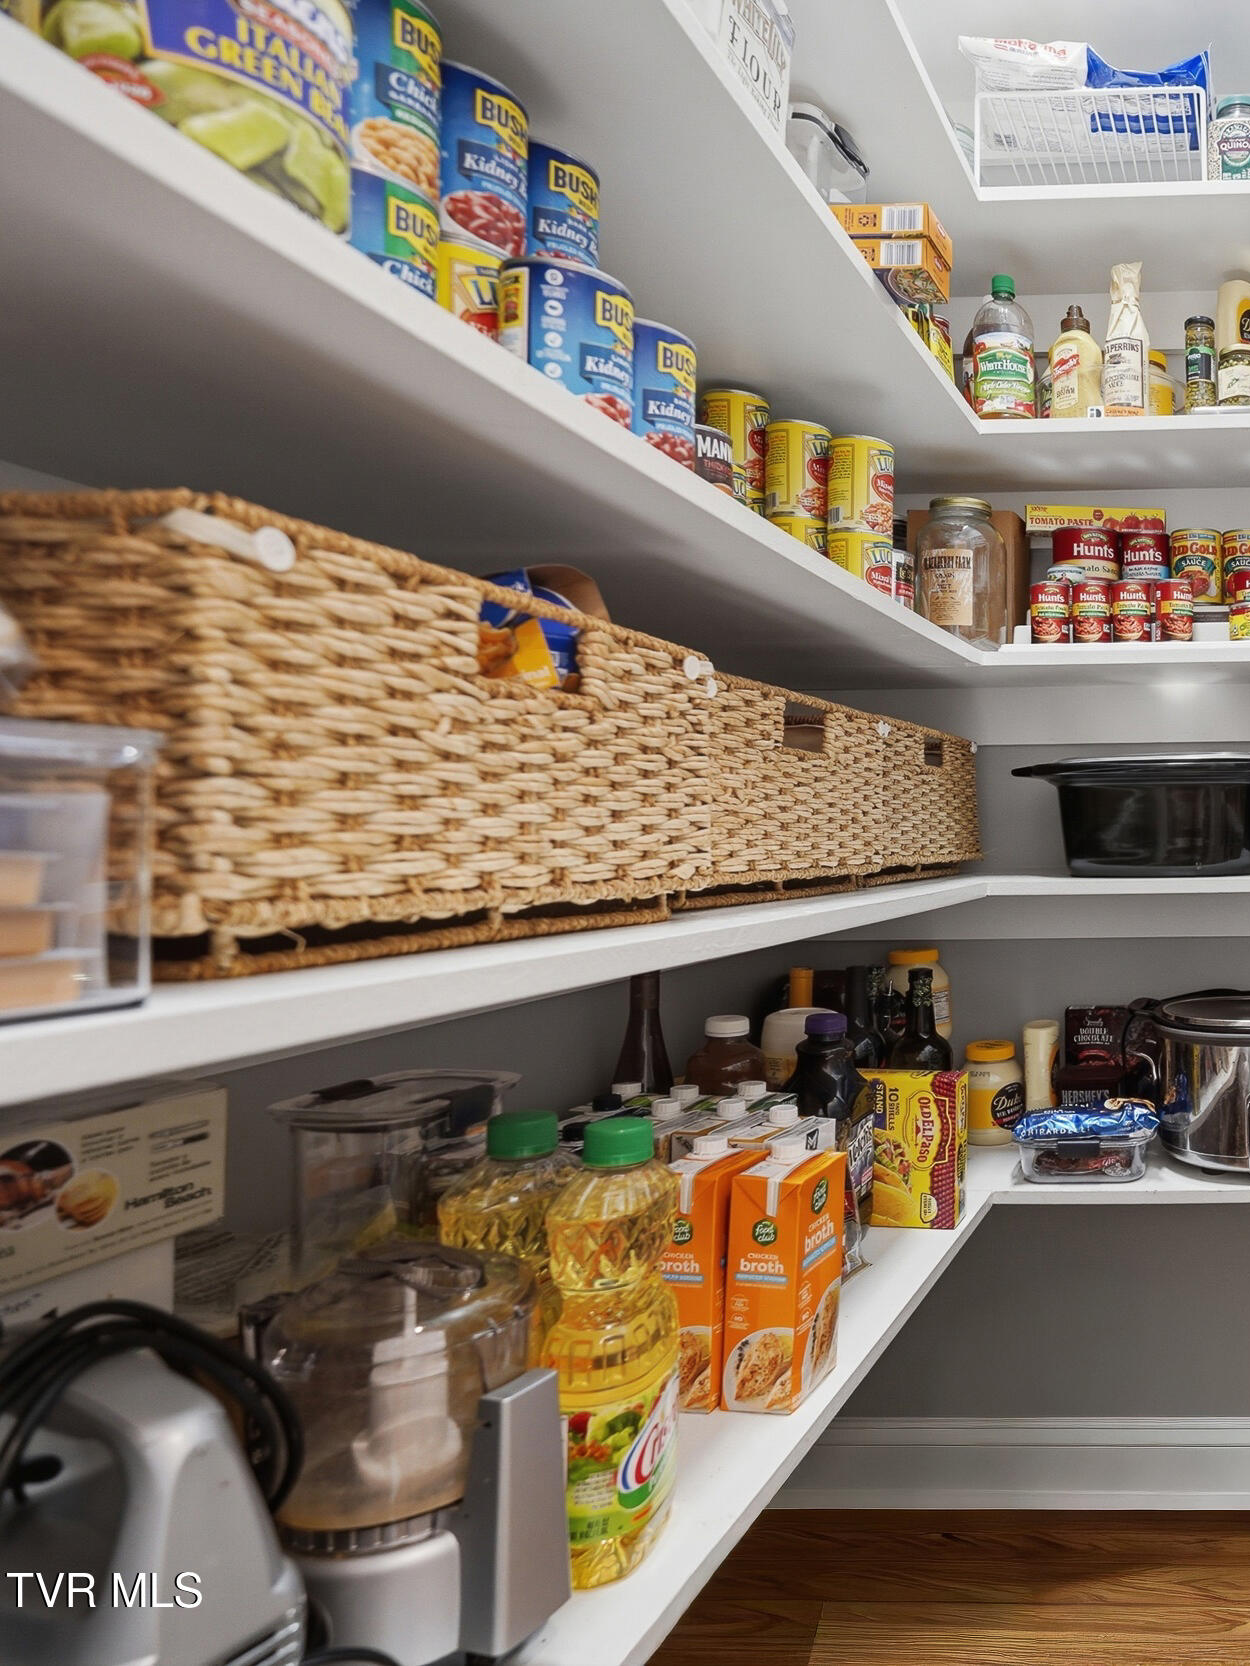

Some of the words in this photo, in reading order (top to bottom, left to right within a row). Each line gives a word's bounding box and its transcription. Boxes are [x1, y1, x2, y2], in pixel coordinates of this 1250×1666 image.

[401, 16, 441, 63] BUS
[237, 17, 341, 109] ITALIAN
[728, 15, 780, 122] FLOUR
[185, 26, 302, 99] GREEN
[309, 86, 349, 143] BEA
[482, 96, 528, 141] BUSH
[463, 153, 520, 191] Kidney
[554, 165, 598, 212] BUSH
[396, 205, 437, 247] BUS
[538, 218, 591, 250] Kidney
[602, 299, 633, 333] BUS
[662, 347, 696, 376] BUS
[647, 399, 692, 428] Kidney
[1029, 517, 1065, 526] TOMATO
[1067, 518, 1094, 527] PASTE
[1073, 543, 1115, 559] Hunt's
[1123, 548, 1162, 563] Hunt's
[1190, 542, 1217, 555] GOLD
[1181, 559, 1206, 567] SAUCE
[1038, 593, 1065, 603] Hunt's
[1079, 592, 1106, 602] Hunt's
[1119, 591, 1146, 601] Hunt's
[1173, 590, 1192, 600] Hunt
[1073, 1034, 1113, 1043] CHOCOLATE
[876, 1083, 884, 1114] STAND
[889, 1087, 899, 1103] 10
[1061, 1089, 1110, 1104] HERSHEY'S
[124, 1182, 195, 1211] Hamilton
[164, 1187, 213, 1210] Beach
[757, 1231, 775, 1242] club
[804, 1220, 835, 1255] broth
[740, 1258, 784, 1273] broth
